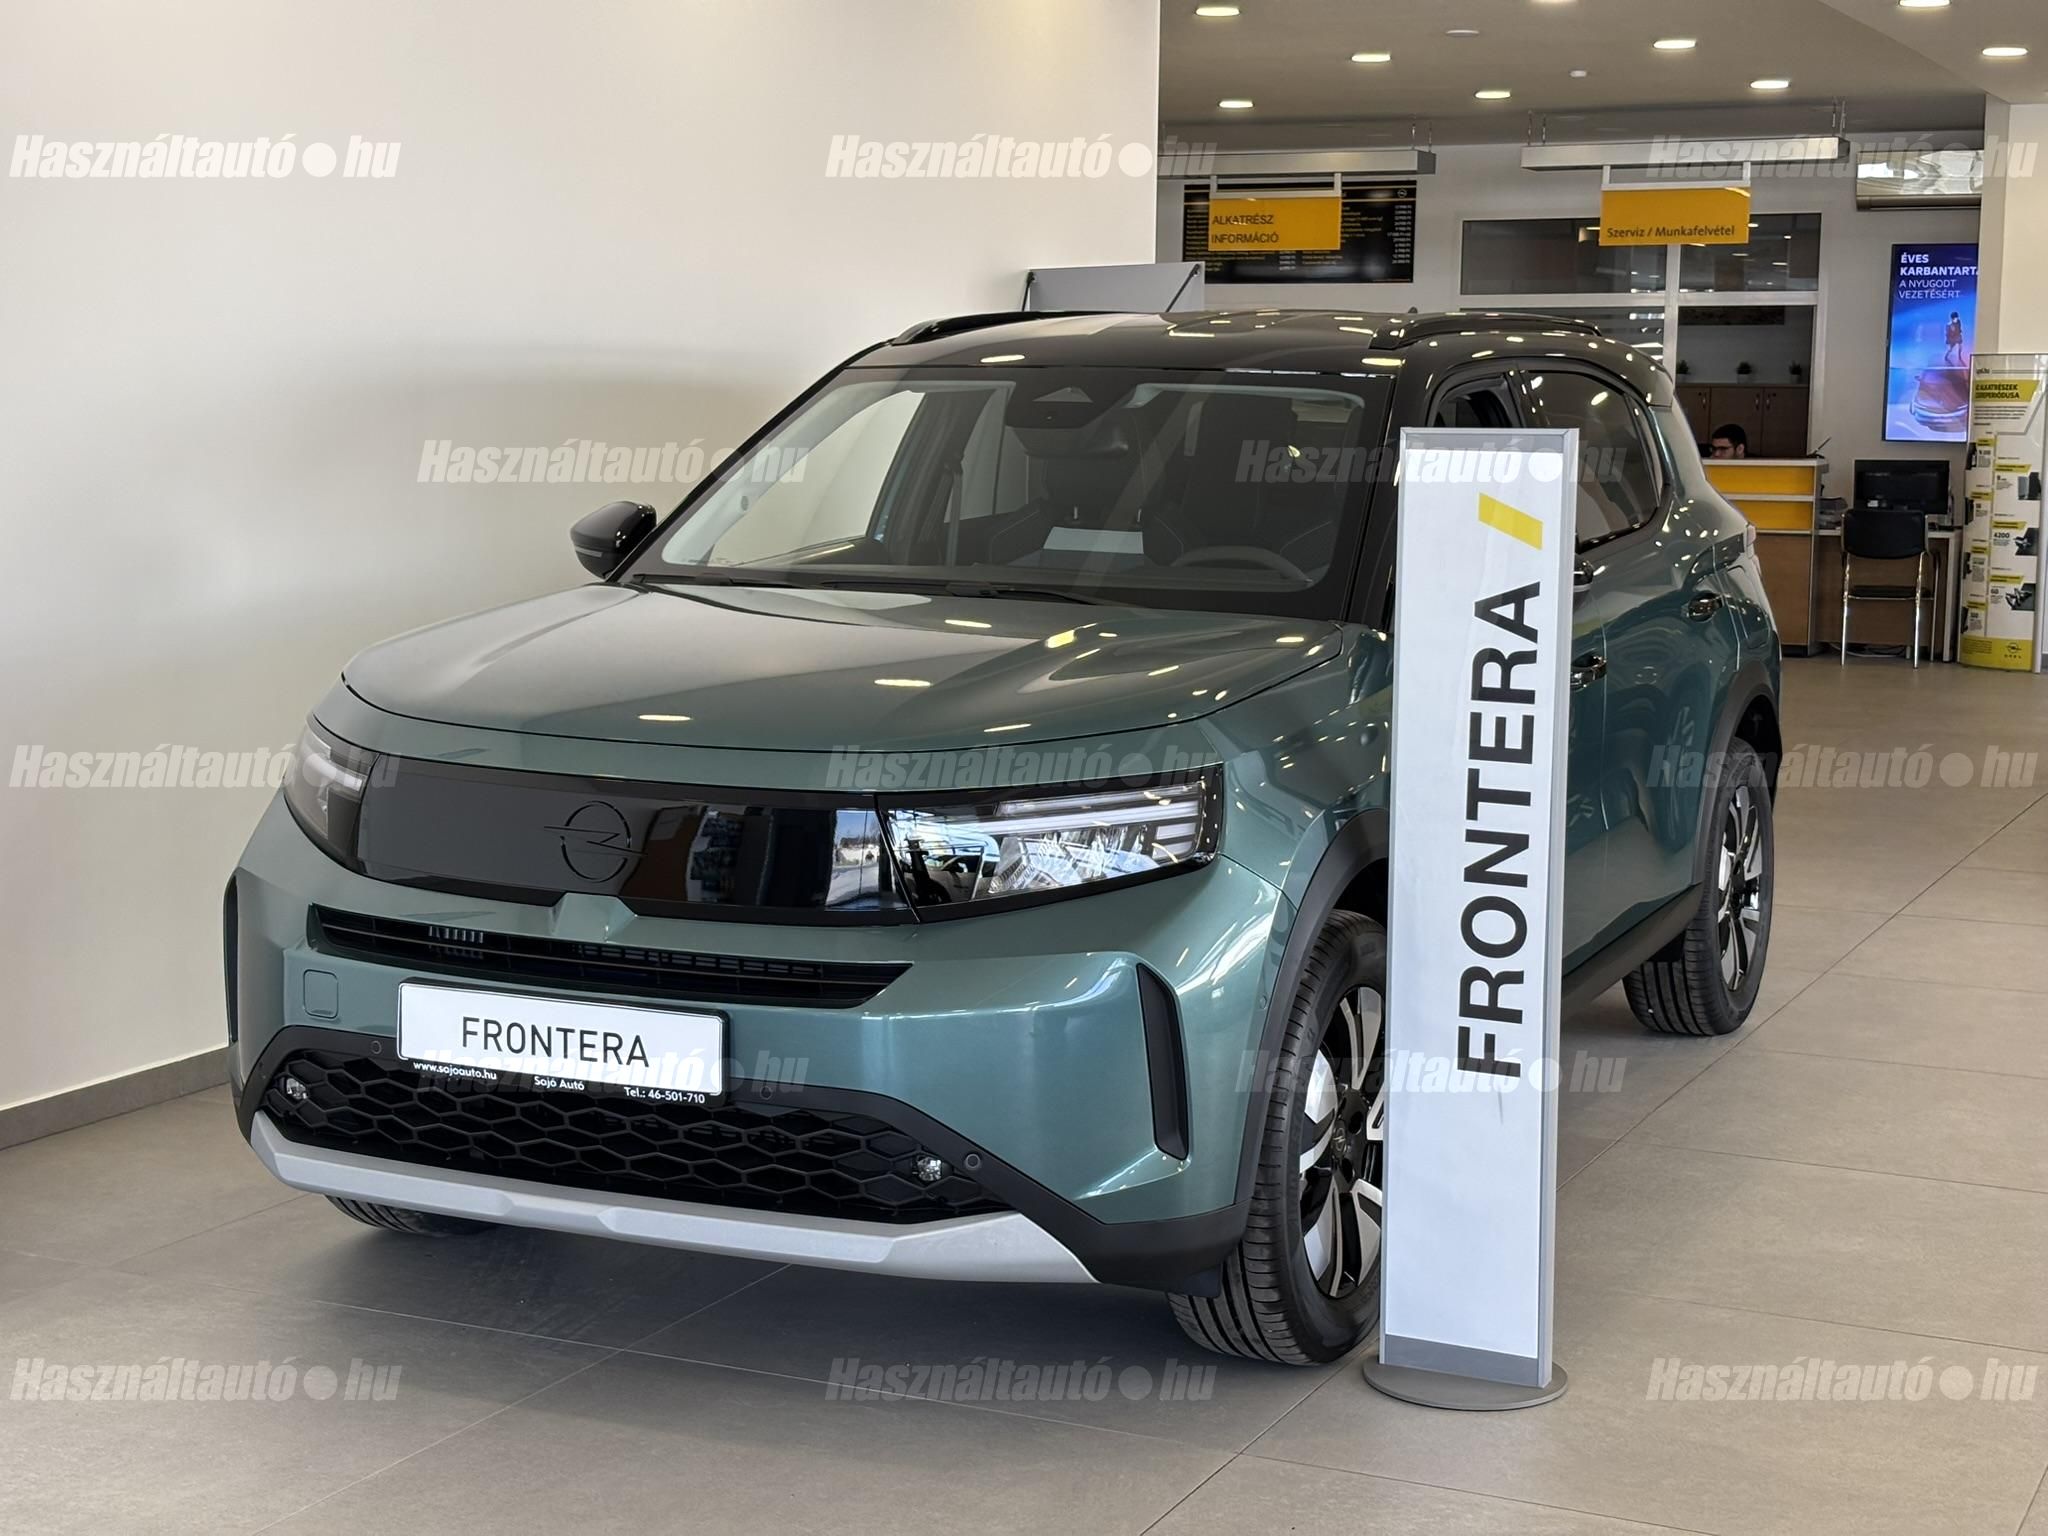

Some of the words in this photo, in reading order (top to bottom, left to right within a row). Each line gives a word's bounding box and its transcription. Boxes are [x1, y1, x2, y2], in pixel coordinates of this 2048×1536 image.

[1212, 213, 1275, 225] ALKATRÉSZ
[1211, 231, 1280, 244] INFORMÁCIÓ
[1607, 226, 1645, 238] Szerviz
[1655, 225, 1736, 237] Munkafelvétel
[1900, 252, 1929, 264] ÉVES
[1899, 280, 1907, 288] A
[1908, 279, 1957, 288] NYUGODT
[1899, 288, 1960, 299] VEZETÉSÉRT
[1456, 581, 1541, 1079] FRONTERA
[462, 1016, 650, 1068] FRONTERA
[413, 1061, 497, 1080] www.sojoauto.hu
[534, 1075, 557, 1090] Sojó
[560, 1078, 585, 1091] Autó
[624, 1086, 646, 1099] Tel.:
[648, 1090, 706, 1104] 46-501-710
